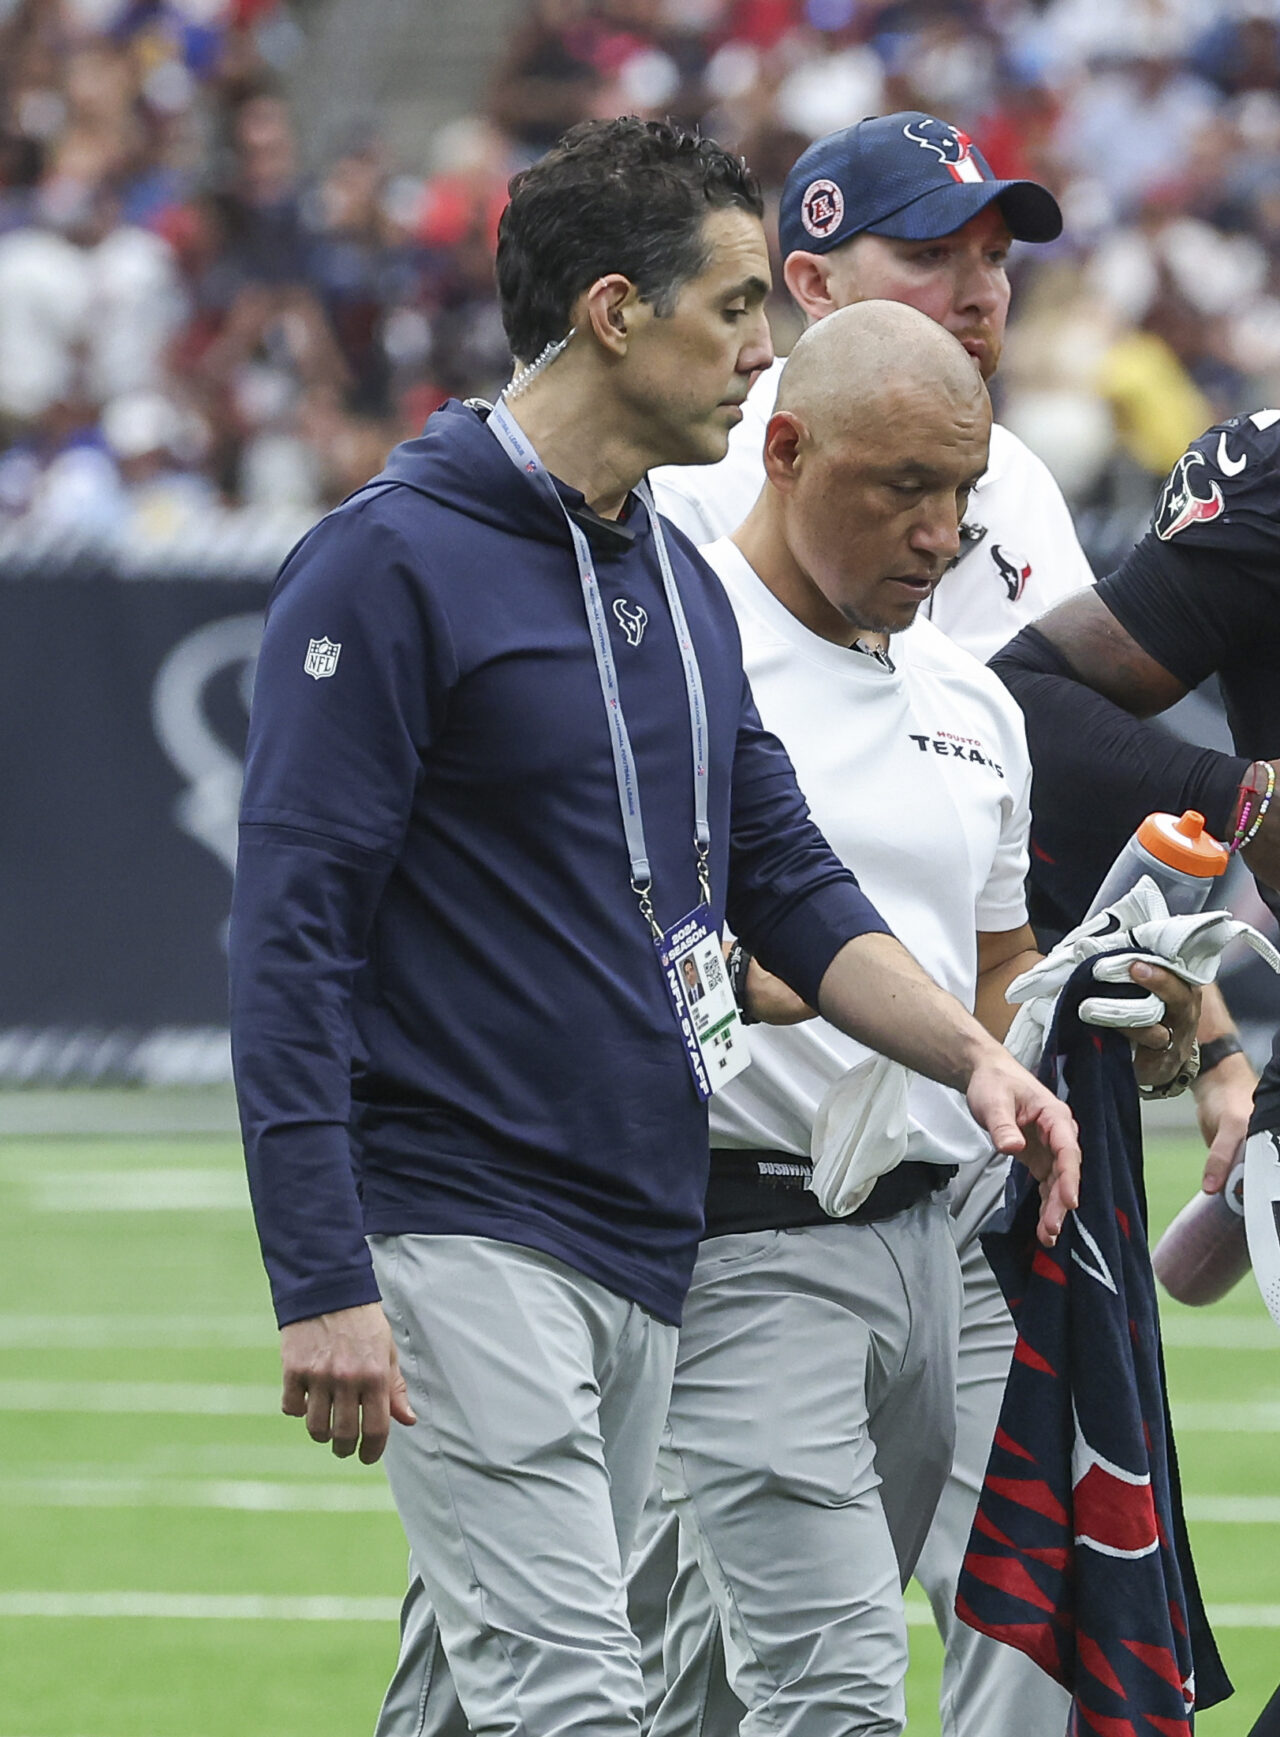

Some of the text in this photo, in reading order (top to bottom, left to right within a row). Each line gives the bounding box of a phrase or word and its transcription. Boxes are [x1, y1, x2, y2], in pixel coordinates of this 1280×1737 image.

[936, 731, 982, 747] HOUSTO
[668, 925, 707, 961] SEASON
[671, 919, 698, 946] 2024
[667, 968, 685, 1017] NFL
[681, 1017, 710, 1095] STAFF
